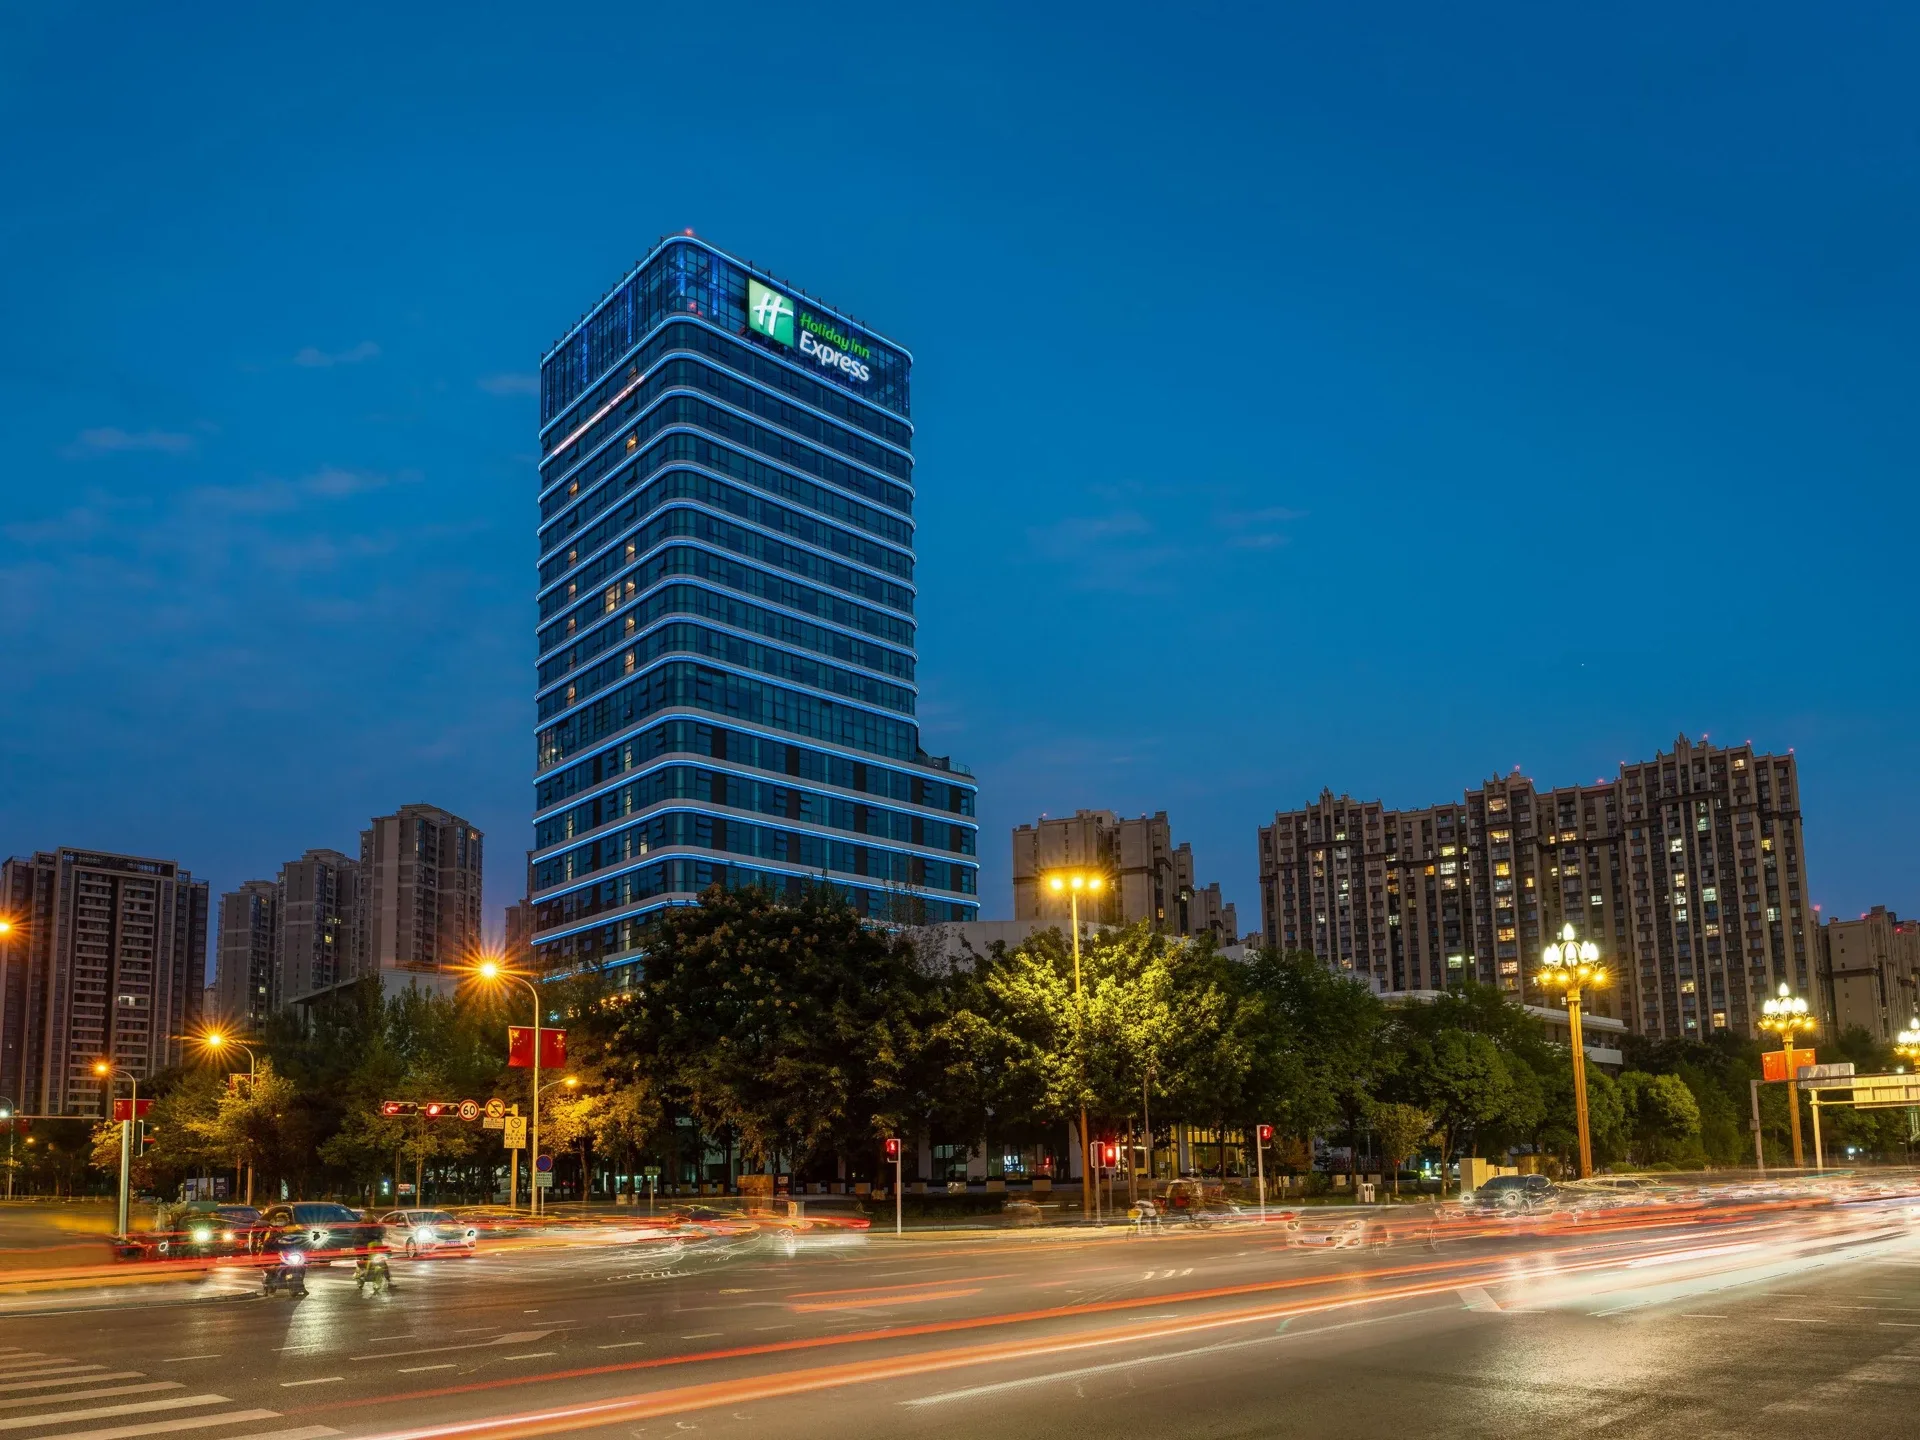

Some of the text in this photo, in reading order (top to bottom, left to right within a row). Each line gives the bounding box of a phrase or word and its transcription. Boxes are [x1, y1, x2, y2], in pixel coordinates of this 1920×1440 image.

[799, 329, 870, 382] Express
[800, 312, 870, 359] Holiday Inn
[463, 1105, 476, 1116] 60
